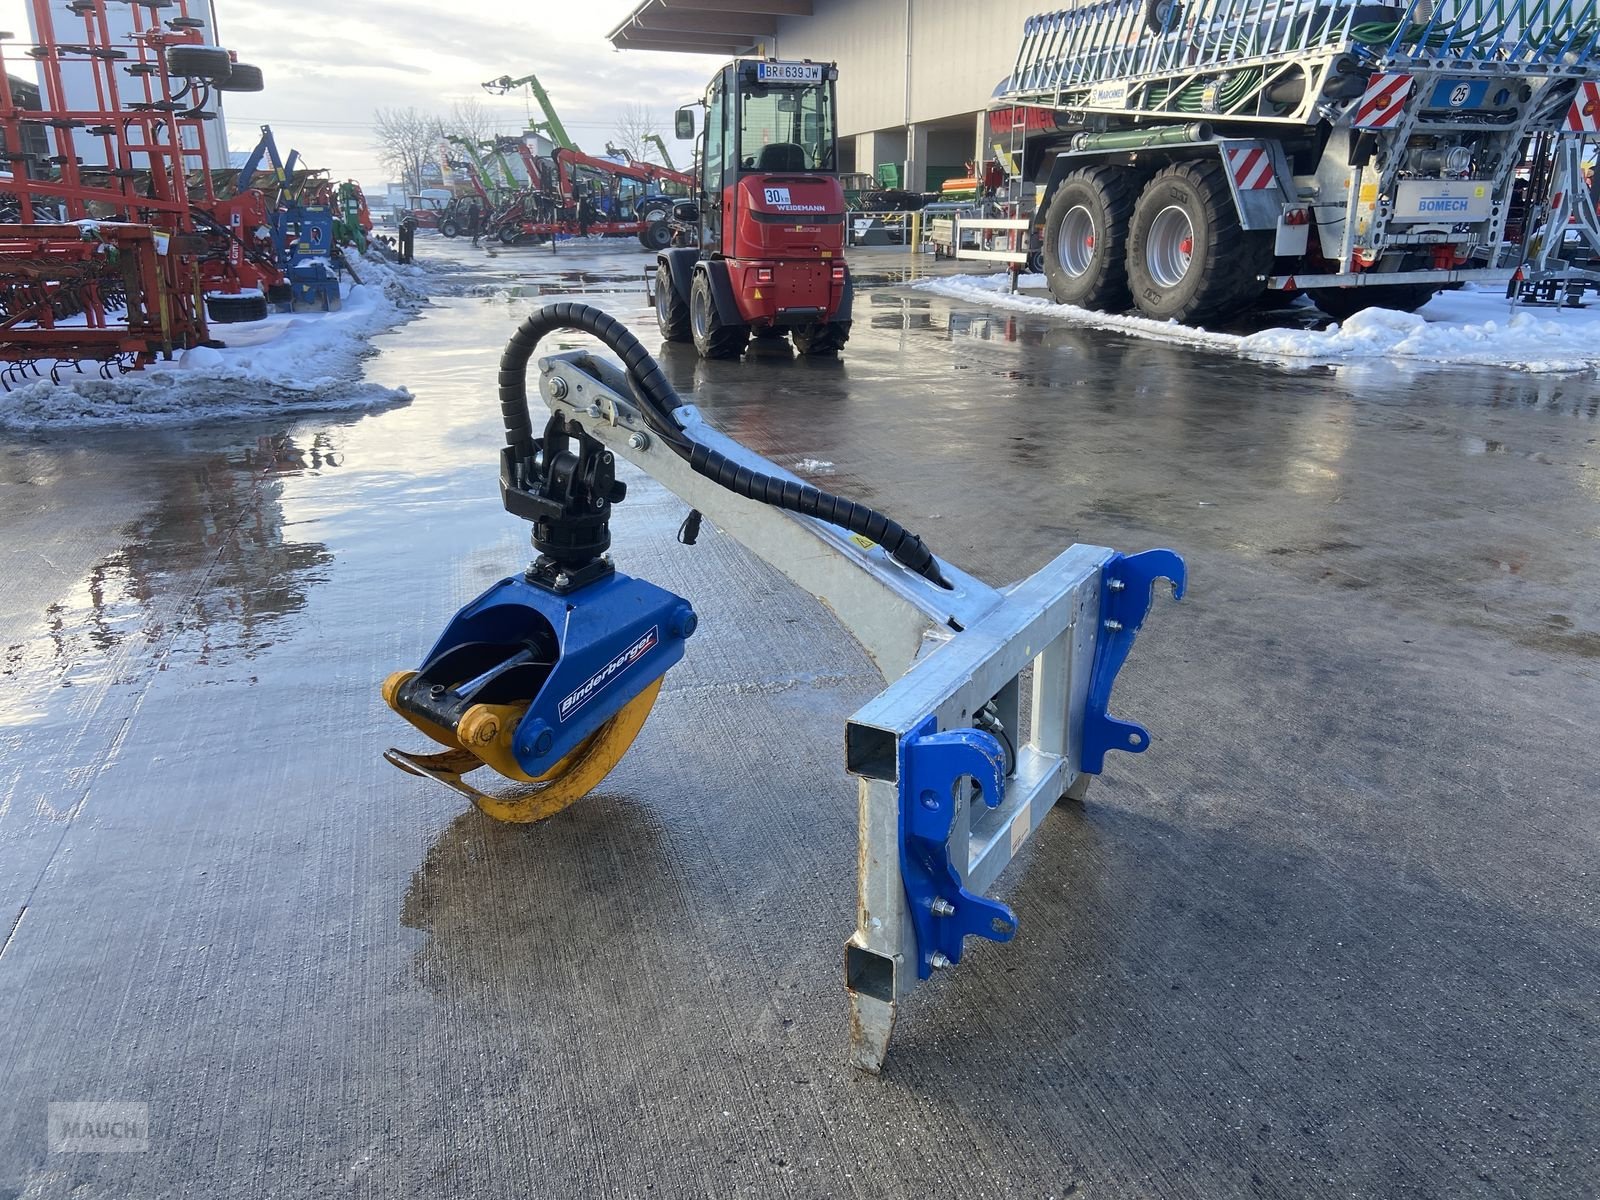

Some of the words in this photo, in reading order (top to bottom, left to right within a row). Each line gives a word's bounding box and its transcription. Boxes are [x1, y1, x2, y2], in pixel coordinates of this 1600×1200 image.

[766, 66, 778, 77] BR
[785, 66, 804, 78] 639
[805, 67, 819, 79] JW
[1452, 87, 1468, 102] 25
[776, 204, 826, 212] WEIDEMANN
[1418, 200, 1468, 211] BOMECH
[561, 632, 653, 713] Binderberger
